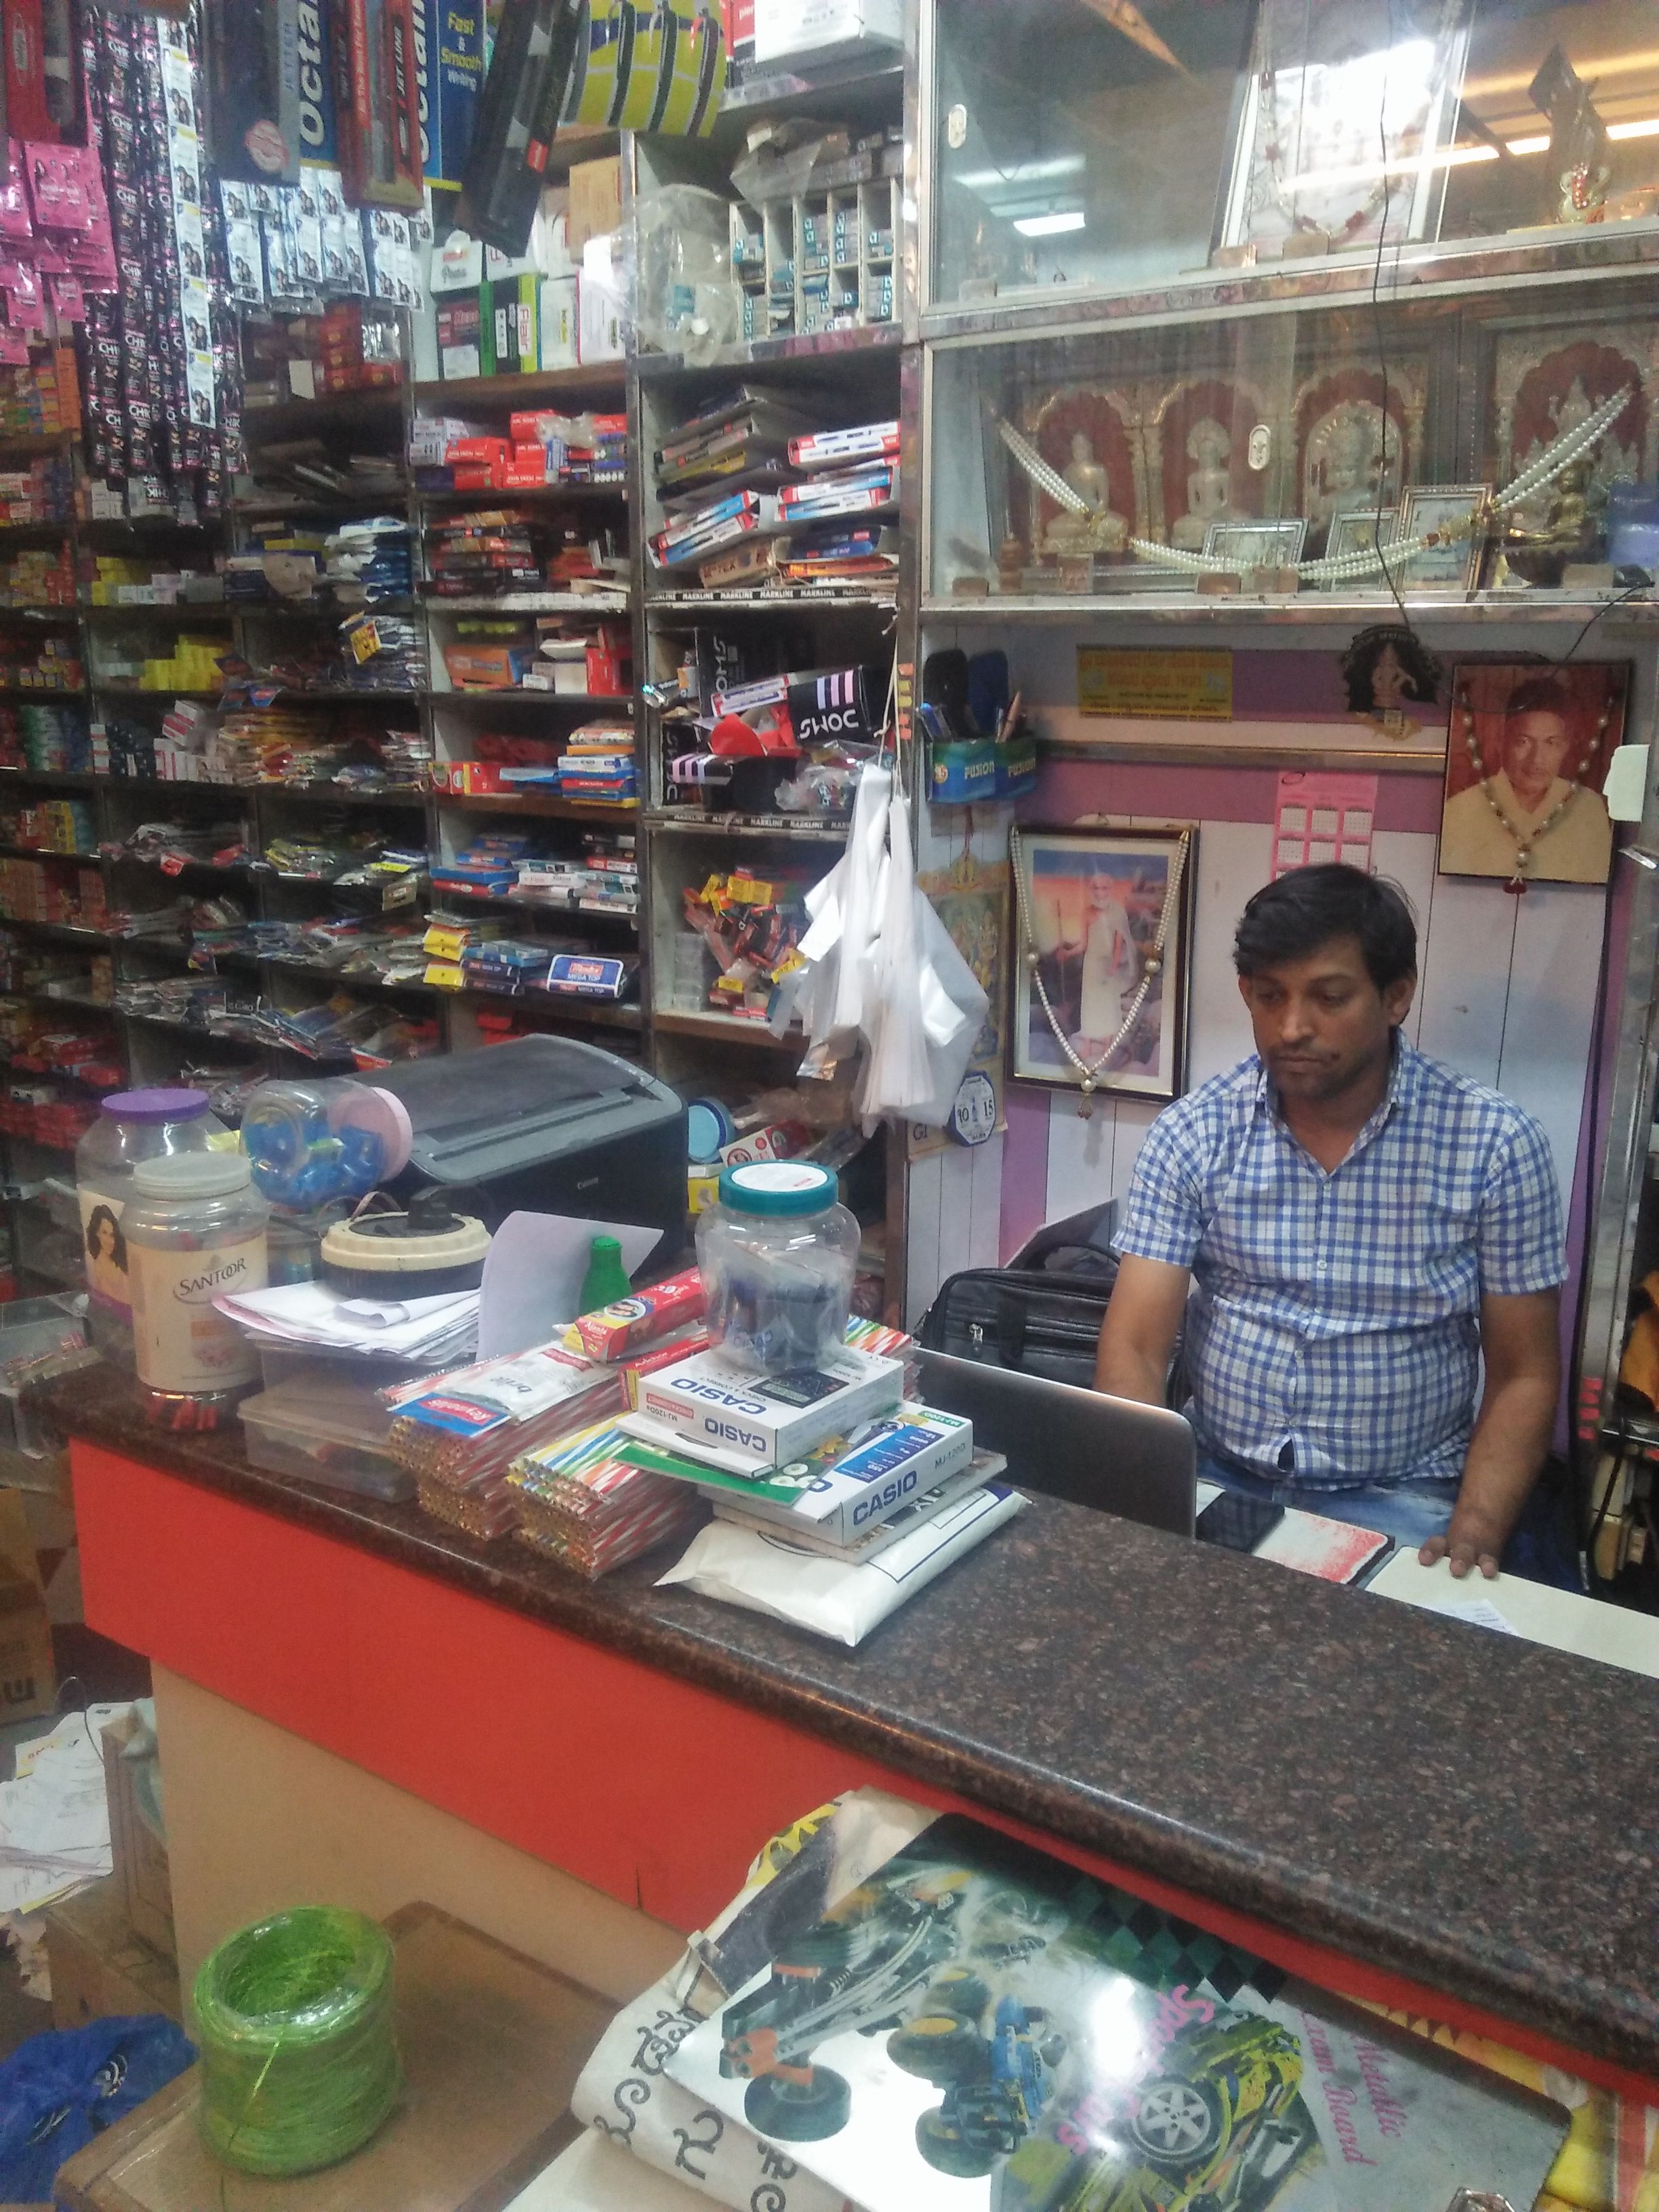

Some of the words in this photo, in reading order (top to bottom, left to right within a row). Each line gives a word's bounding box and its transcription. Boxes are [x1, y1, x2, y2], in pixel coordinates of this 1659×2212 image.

[448, 12, 474, 35] Fast
[457, 36, 466, 53] &
[441, 47, 483, 71] Smooth
[299, 0, 325, 146] Octa
[682, 592, 714, 600] MARKLINE
[720, 590, 754, 600] MARKLINE
[760, 589, 794, 598] MARKLINE
[800, 588, 836, 598] MARKLINE
[798, 708, 859, 740] DOMS
[751, 818, 783, 827] MARKLINE
[790, 820, 824, 830] MARKLINE
[567, 973, 586, 982] MEGA
[588, 975, 601, 983] TOP
[983, 1099, 994, 1117] 15
[179, 1257, 247, 1296] SANTOOR
[670, 1378, 767, 1416] CASIO
[647, 1404, 678, 1422] MJ-120Da
[704, 1417, 767, 1452] CASIO
[934, 1443, 966, 1469] MJ-120D
[853, 1470, 918, 1526] CASIO
[1322, 2081, 1379, 2167] Board
